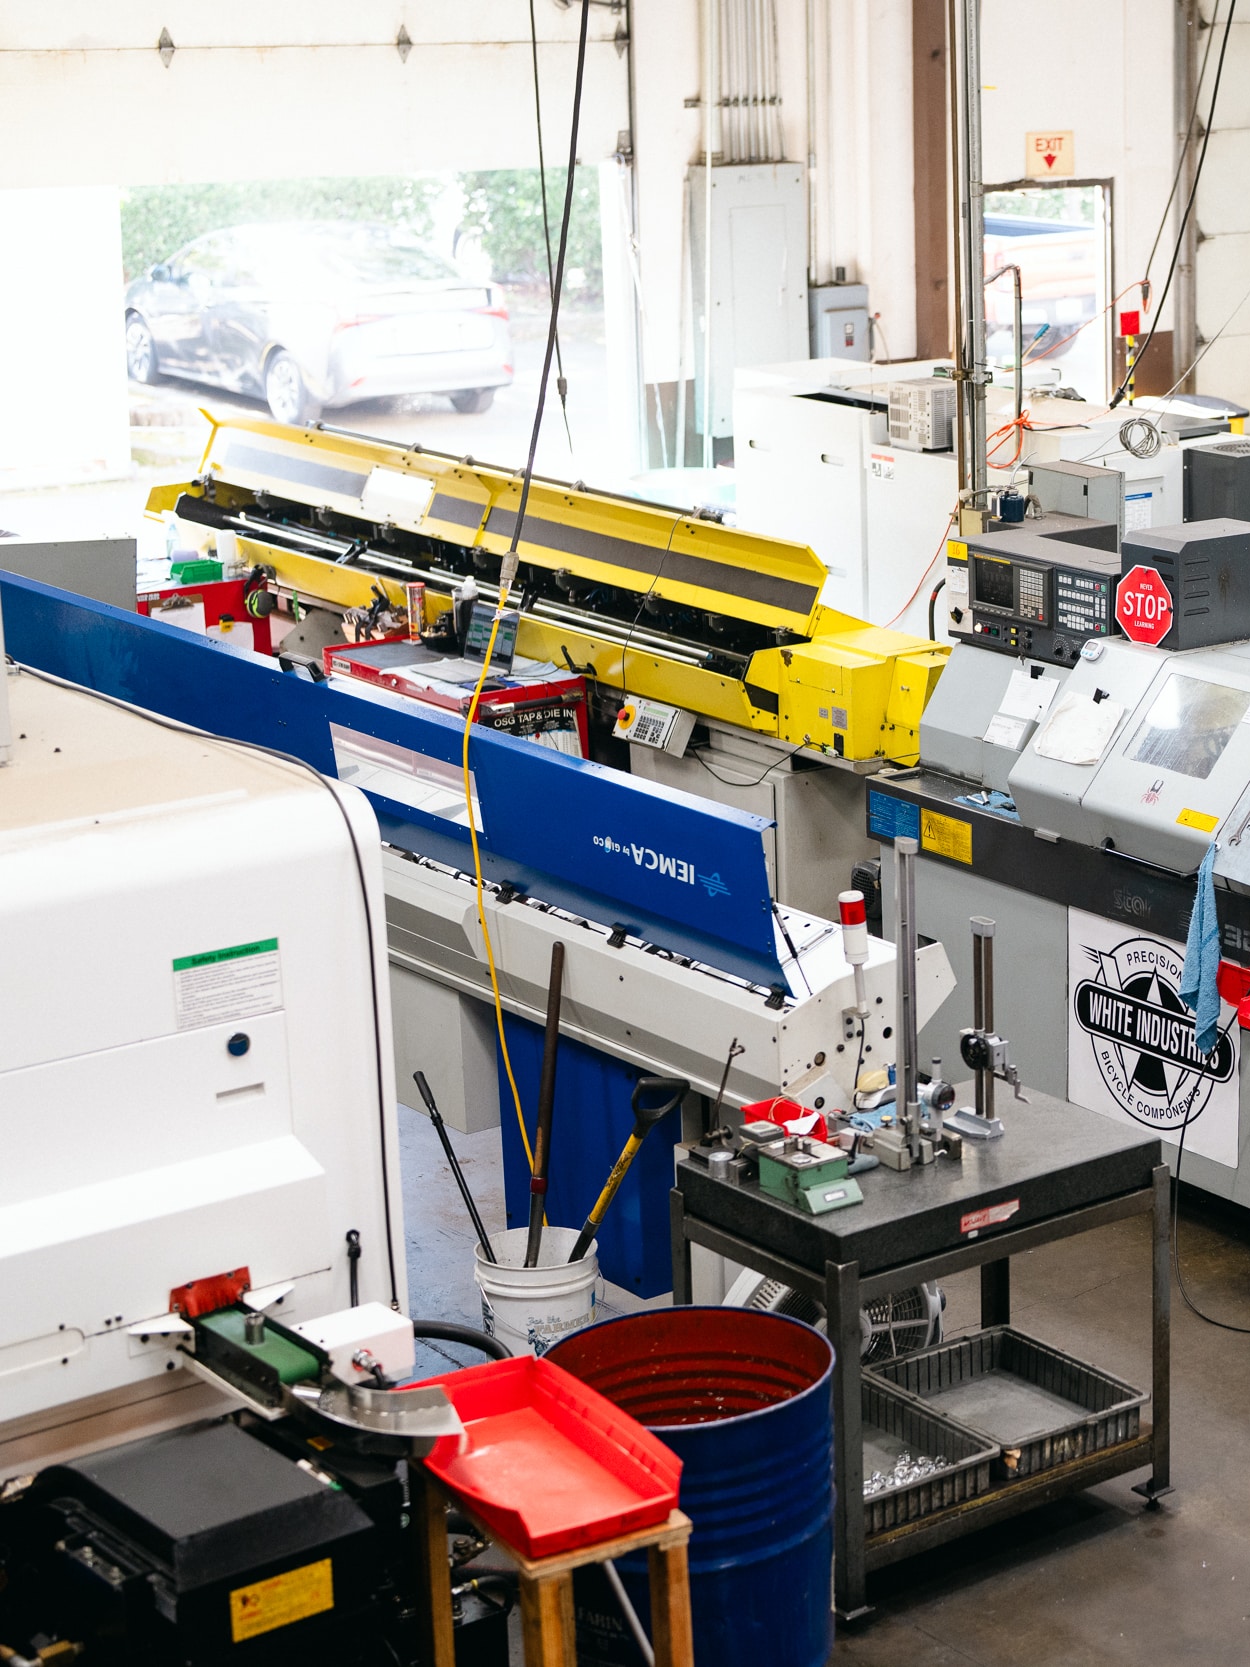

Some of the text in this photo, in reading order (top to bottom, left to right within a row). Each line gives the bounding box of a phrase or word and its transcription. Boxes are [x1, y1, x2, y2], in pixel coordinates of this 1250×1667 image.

[1035, 137, 1064, 152] EXIT
[1139, 583, 1153, 591] NEVER
[1123, 591, 1168, 620] STOP
[1134, 620, 1155, 630] LEARNING
[494, 716, 516, 728] OSG
[593, 835, 695, 885] IEMCA by GICO
[191, 946, 260, 965] Safety Instruction
[1126, 950, 1182, 984] PRECISION
[1089, 991, 1134, 1037] WHITE
[1101, 1050, 1134, 1106] BICYCLE
[1136, 1086, 1201, 1120] COMPONENTS
